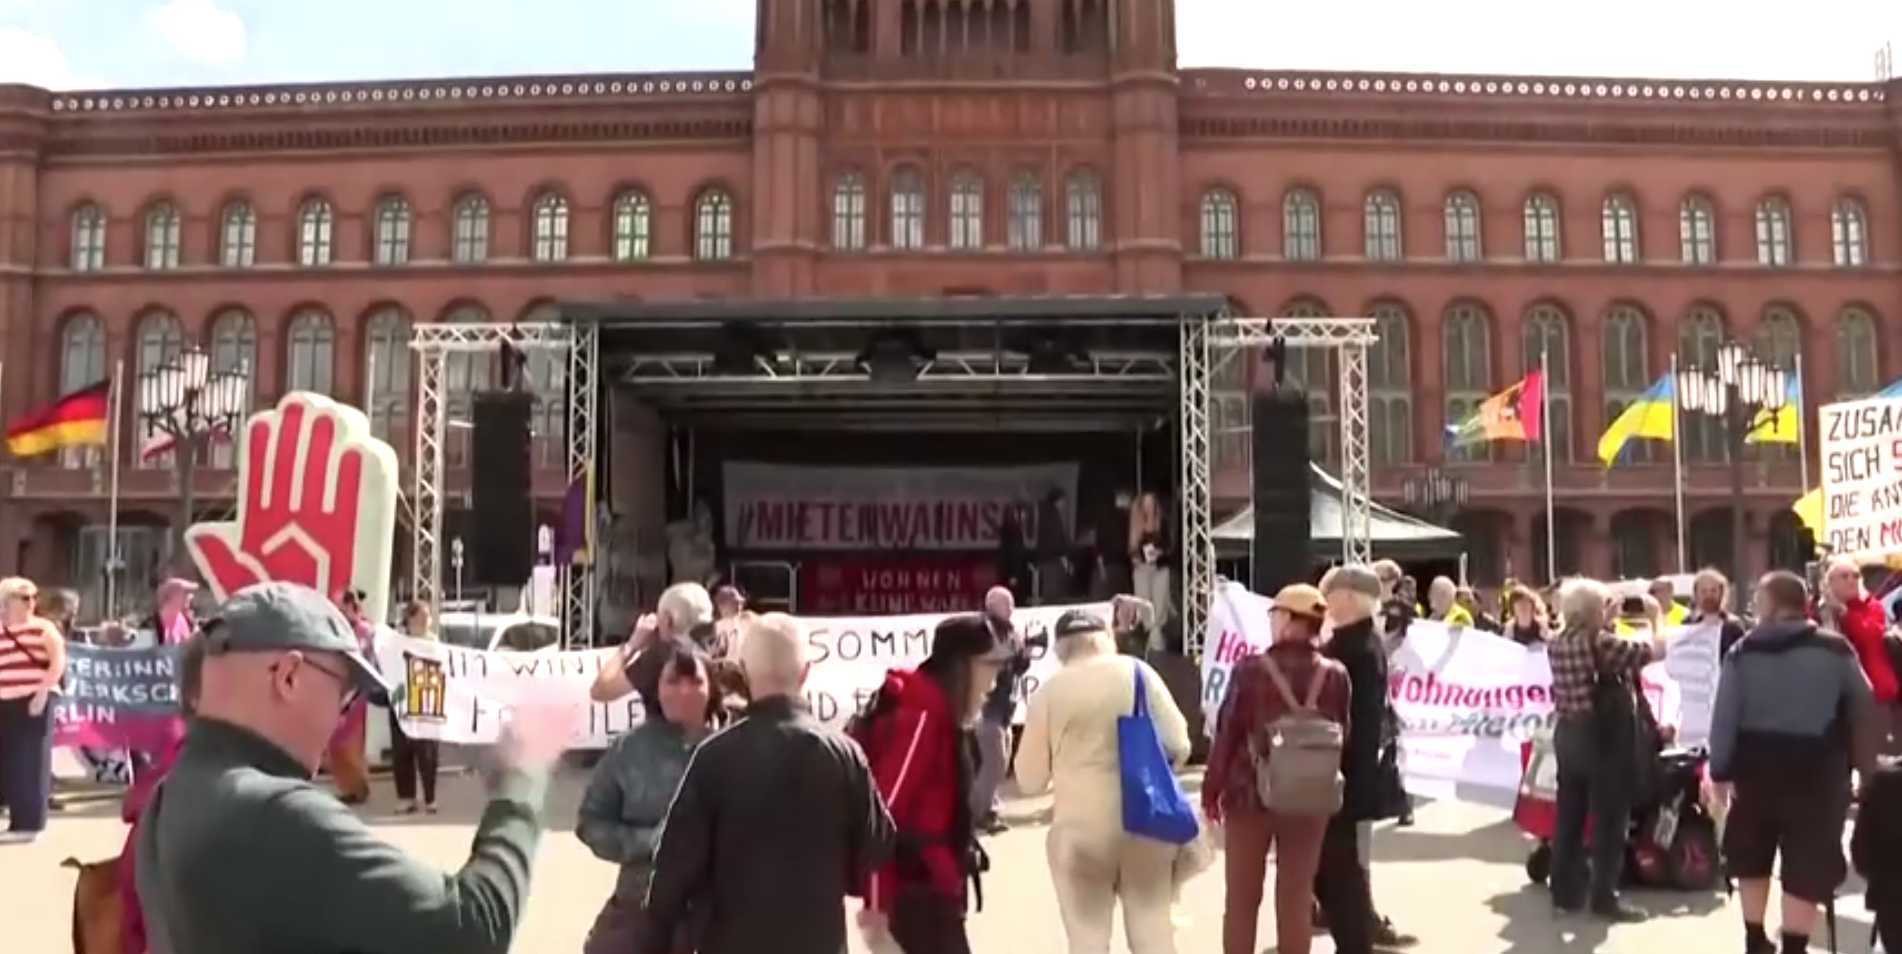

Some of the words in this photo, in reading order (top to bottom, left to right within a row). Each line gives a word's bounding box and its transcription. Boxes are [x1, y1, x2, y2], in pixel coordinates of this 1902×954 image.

[1828, 405, 1902, 441] ZUSA
[1828, 444, 1880, 484] SICH
[1829, 491, 1859, 519] DIE
[1871, 480, 1902, 512] AN
[1829, 526, 1870, 555] DEN
[808, 628, 929, 664] SOMM
[54, 703, 116, 725] RLIN
